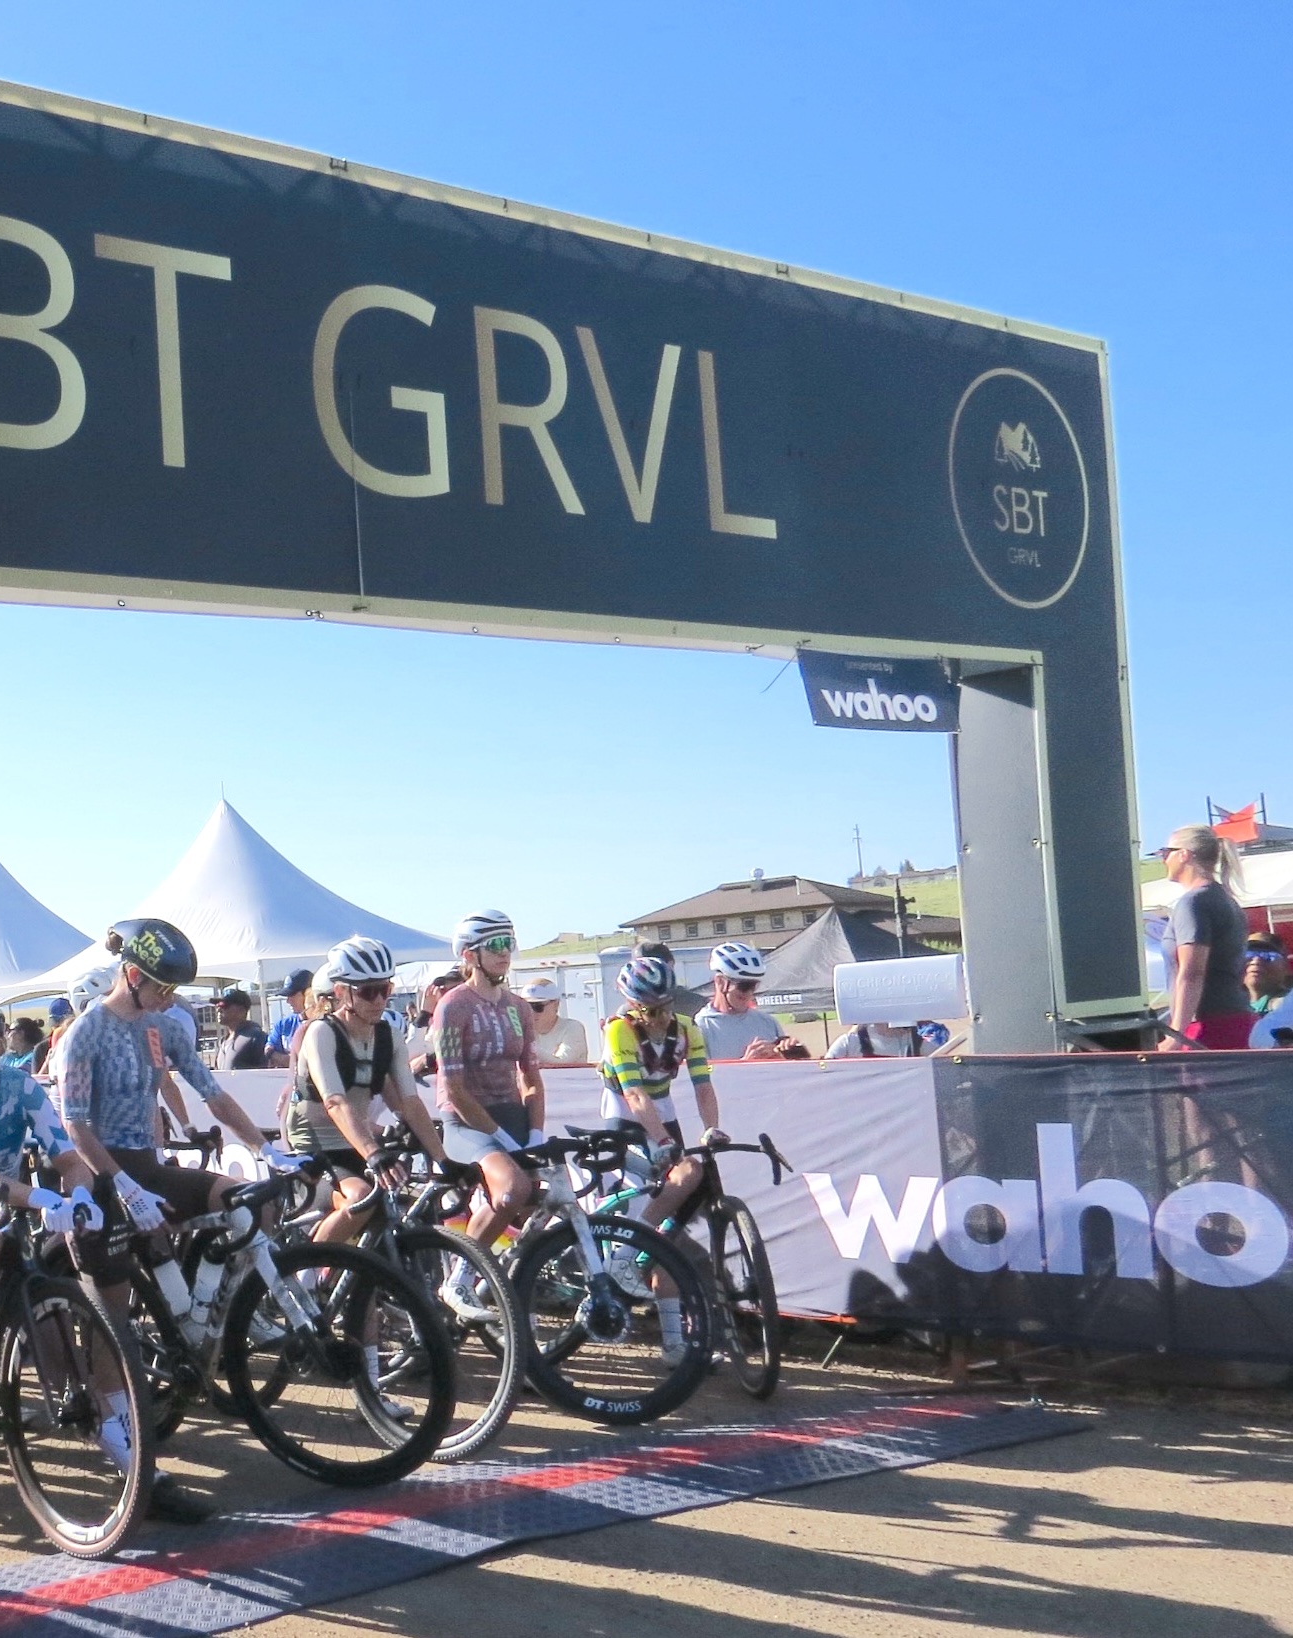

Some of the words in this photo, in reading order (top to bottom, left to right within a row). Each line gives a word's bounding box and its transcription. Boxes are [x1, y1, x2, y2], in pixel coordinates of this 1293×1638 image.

[313, 284, 778, 539] GRVL
[993, 485, 1048, 537] SBT
[821, 678, 938, 722] wahoo
[802, 1122, 1291, 1289] waho
[584, 1396, 605, 1410] DT
[606, 1401, 642, 1413] SWISS
